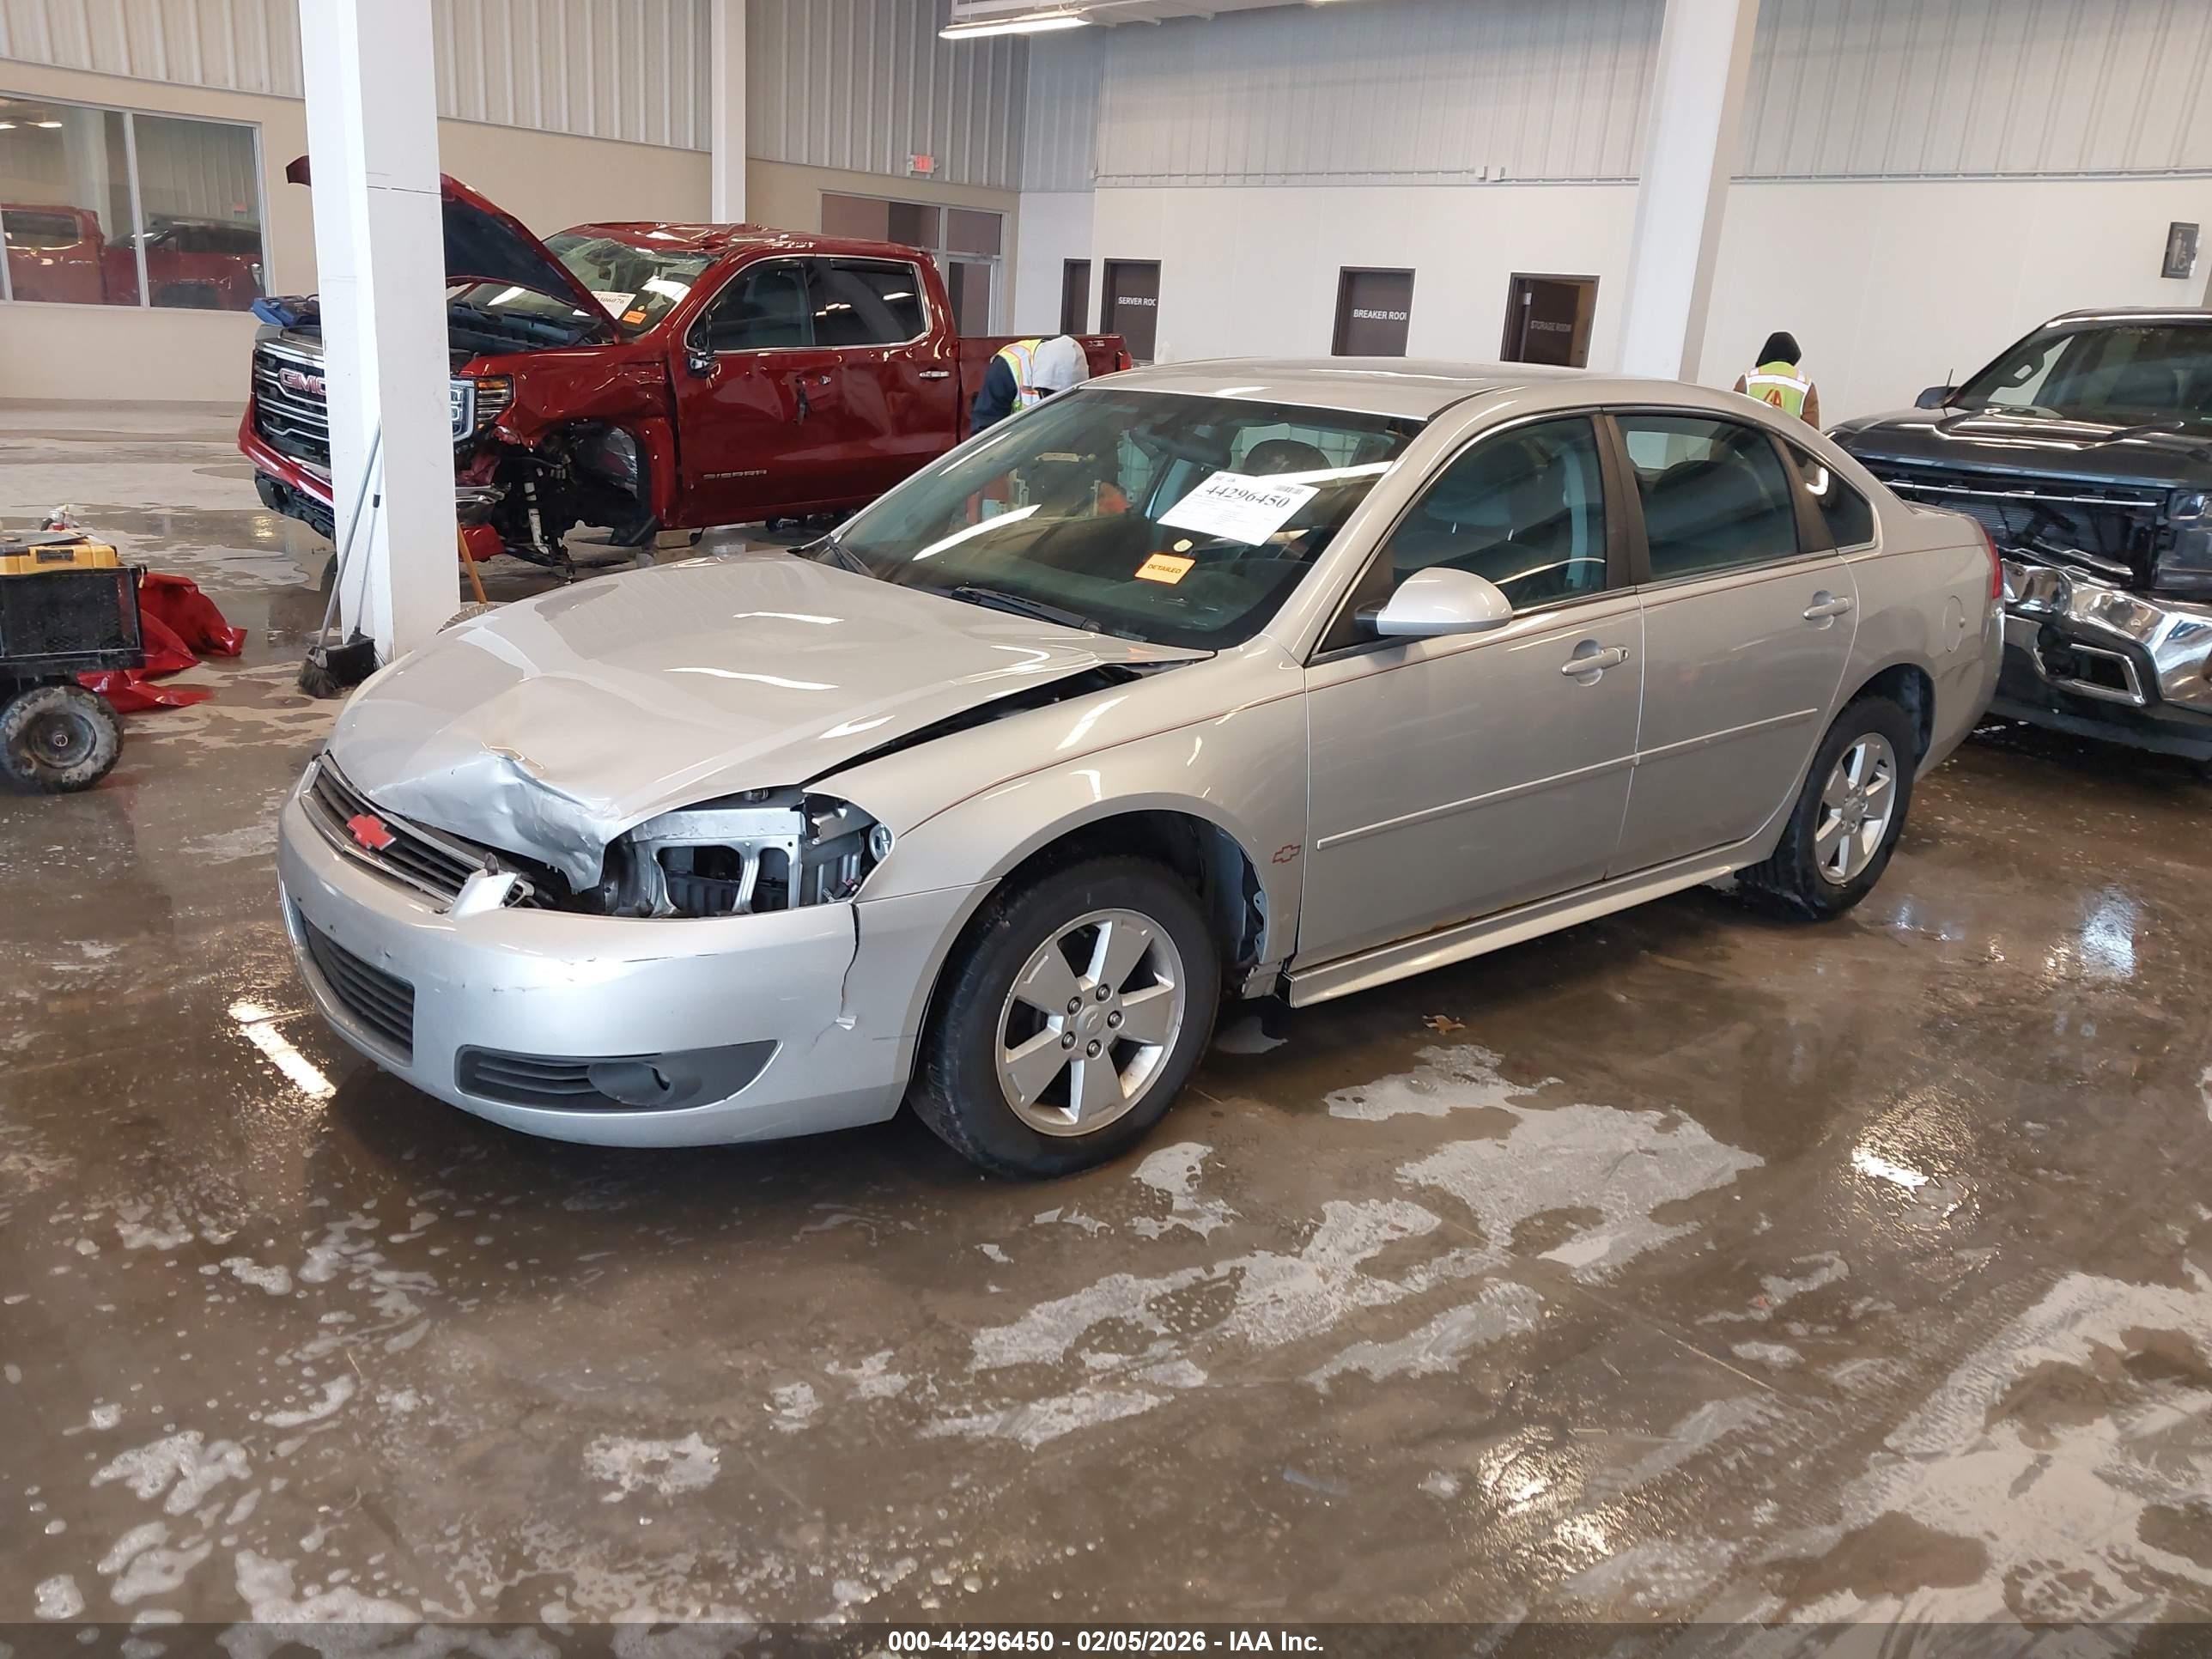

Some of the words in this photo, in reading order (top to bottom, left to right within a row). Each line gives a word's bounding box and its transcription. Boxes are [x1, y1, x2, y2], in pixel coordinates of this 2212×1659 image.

[1118, 296, 1142, 306] SERVER
[1353, 309, 1387, 319] BREAKER
[279, 368, 326, 396] GMC
[1206, 485, 1291, 508] 44296450
[1147, 563, 1182, 574] DETAILED
